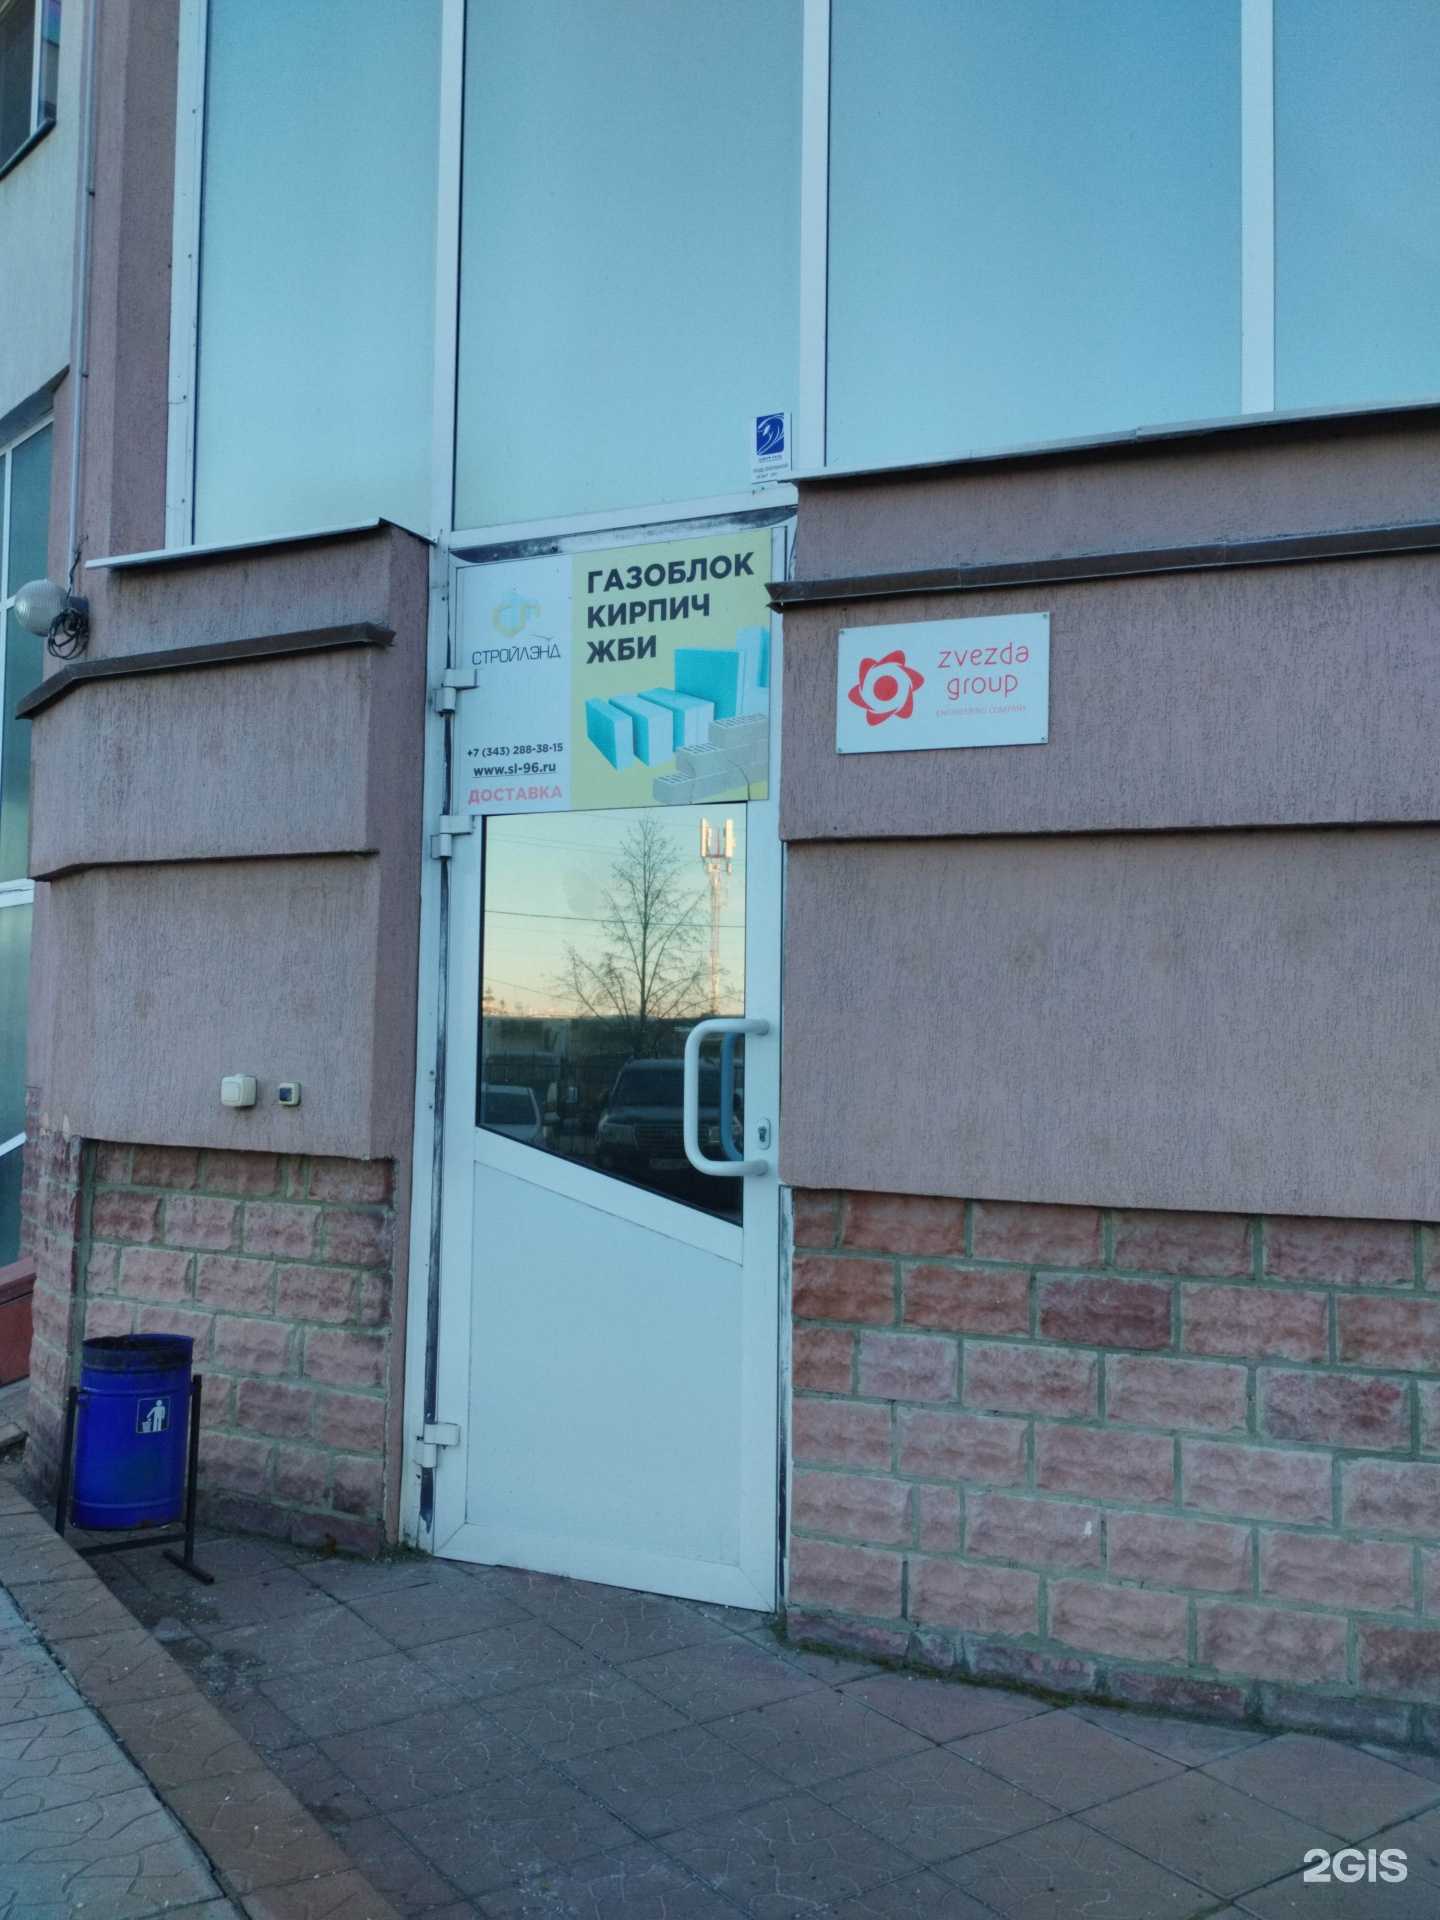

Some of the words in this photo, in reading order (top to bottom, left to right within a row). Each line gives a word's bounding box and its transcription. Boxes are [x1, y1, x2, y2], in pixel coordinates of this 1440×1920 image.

[587, 552, 754, 594] ГАЗОБЛОК
[586, 593, 710, 629] КИРПИЧ
[472, 643, 561, 666] СТРОЙЛЭНД
[586, 635, 657, 664] ЖБИ
[937, 641, 1030, 669] zvezda
[946, 674, 1018, 701] group
[467, 748, 480, 758] +7
[481, 746, 510, 758] (343)
[512, 742, 564, 755] 288-38-15
[473, 762, 556, 777] www.sl-96.ru
[468, 785, 562, 805] ДОСТАВКА
